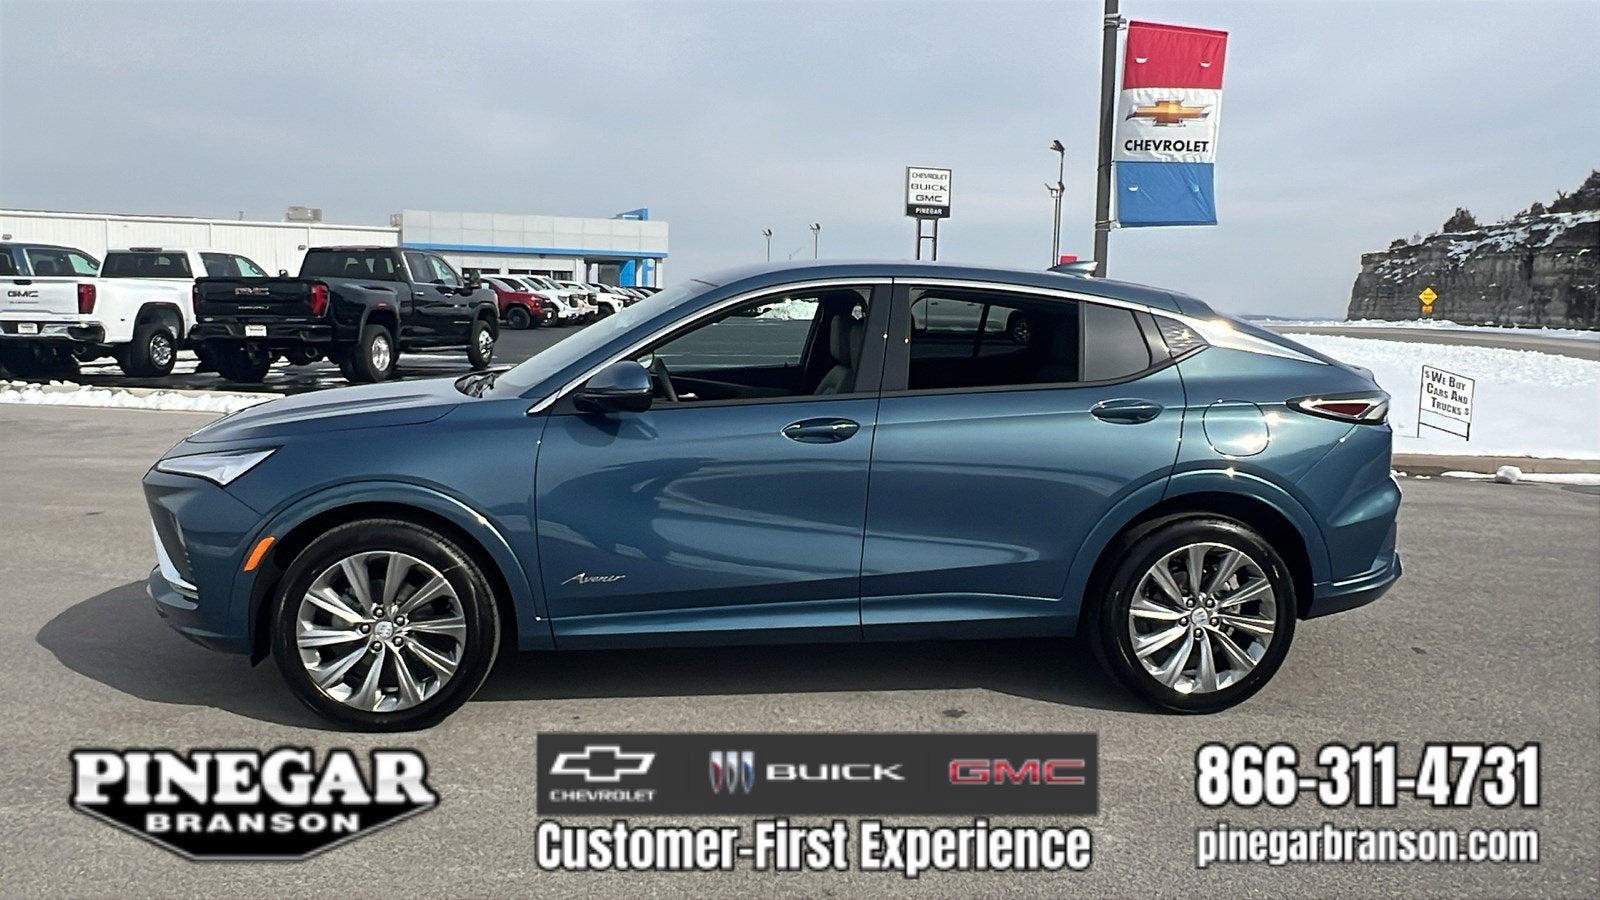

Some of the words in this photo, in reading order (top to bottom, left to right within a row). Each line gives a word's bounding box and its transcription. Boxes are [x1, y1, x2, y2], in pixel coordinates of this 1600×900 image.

[1124, 139, 1209, 153] CHEVROLET
[911, 172, 948, 181] CHEVROLET
[910, 183, 947, 192] BUICK
[915, 194, 943, 203] GMC
[915, 207, 943, 215] PINEGAR
[7, 290, 39, 298] GMC
[561, 572, 626, 586] Avenir
